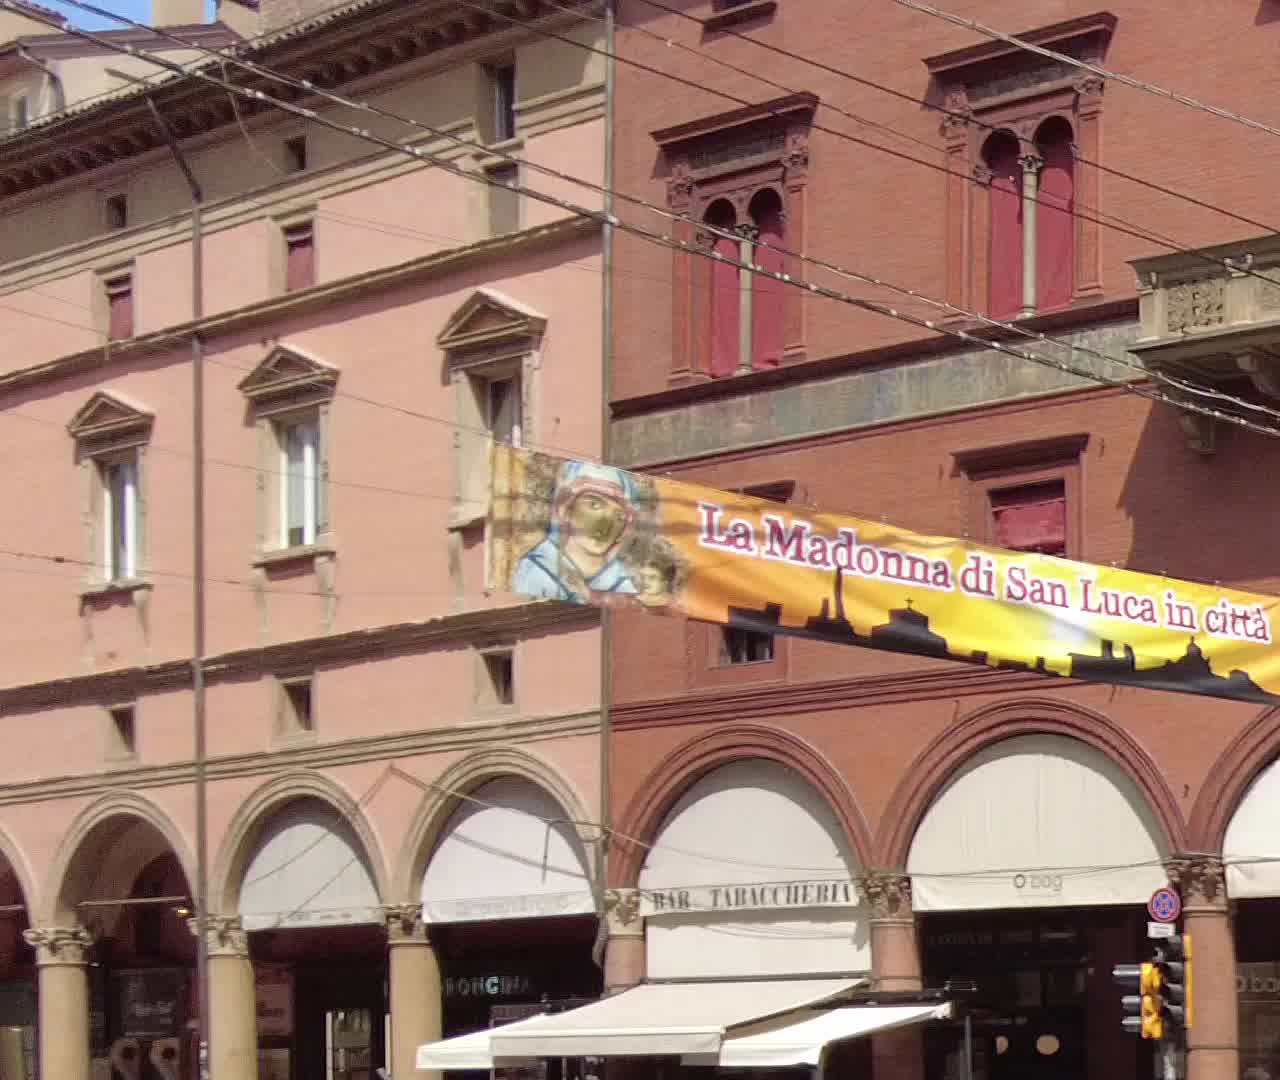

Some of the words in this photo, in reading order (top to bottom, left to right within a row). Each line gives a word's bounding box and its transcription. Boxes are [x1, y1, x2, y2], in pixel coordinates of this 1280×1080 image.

[700, 502, 754, 552] La
[763, 515, 952, 589] Madonna
[960, 555, 995, 597] di
[1006, 566, 1069, 608] San
[1080, 578, 1157, 624] Luca
[1165, 591, 1196, 630] in
[1205, 601, 1270, 642] città
[652, 890, 690, 910] BAR
[710, 882, 850, 908] TABACCHERIA
